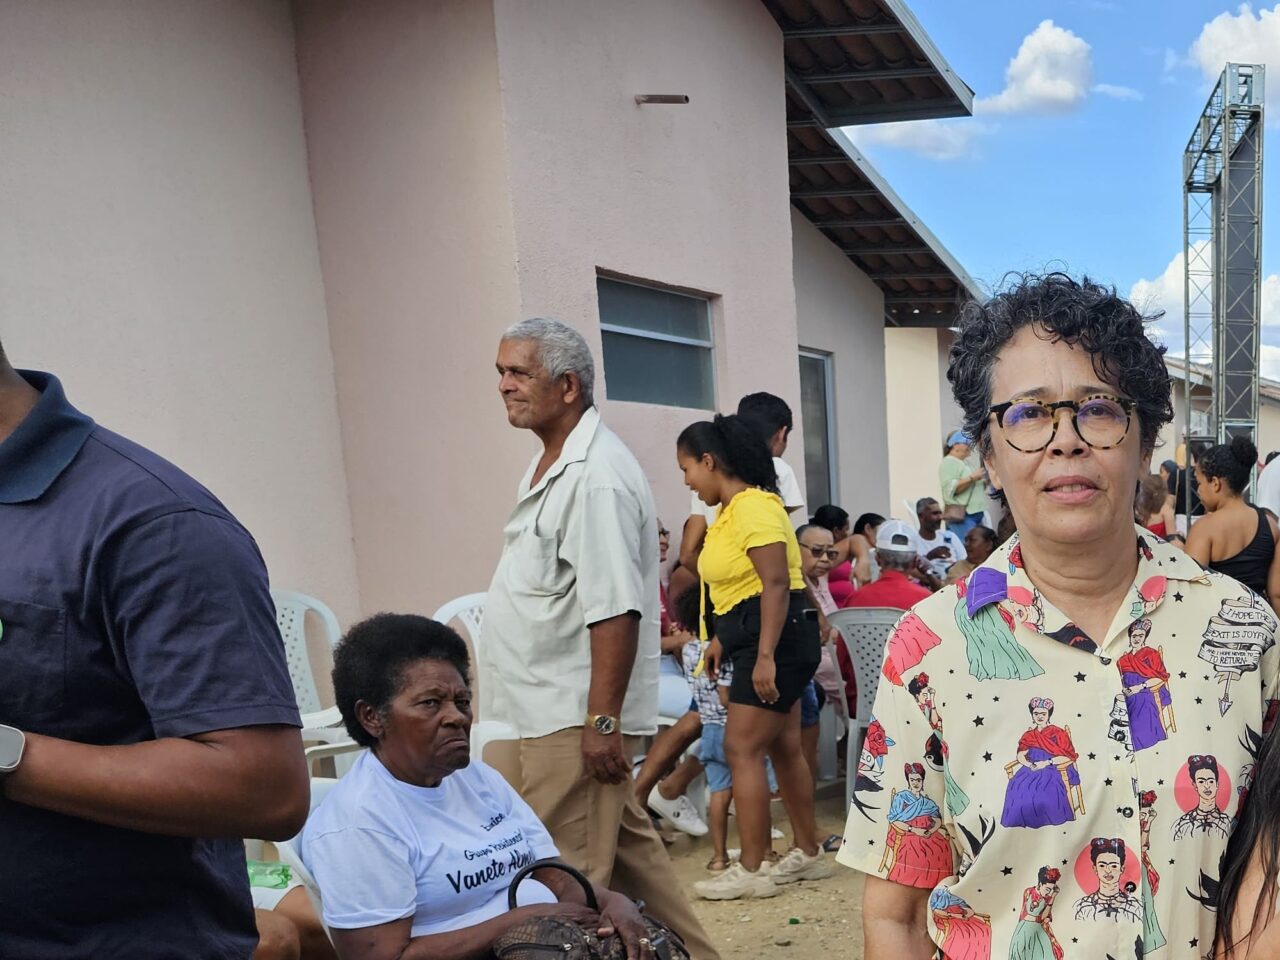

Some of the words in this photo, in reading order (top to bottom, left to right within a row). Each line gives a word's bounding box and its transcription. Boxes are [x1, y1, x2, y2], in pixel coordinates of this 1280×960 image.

[1231, 610, 1254, 620] HOPE
[1255, 611, 1269, 623] THE
[1232, 630, 1240, 638] IS
[446, 858, 506, 894] Vanete
